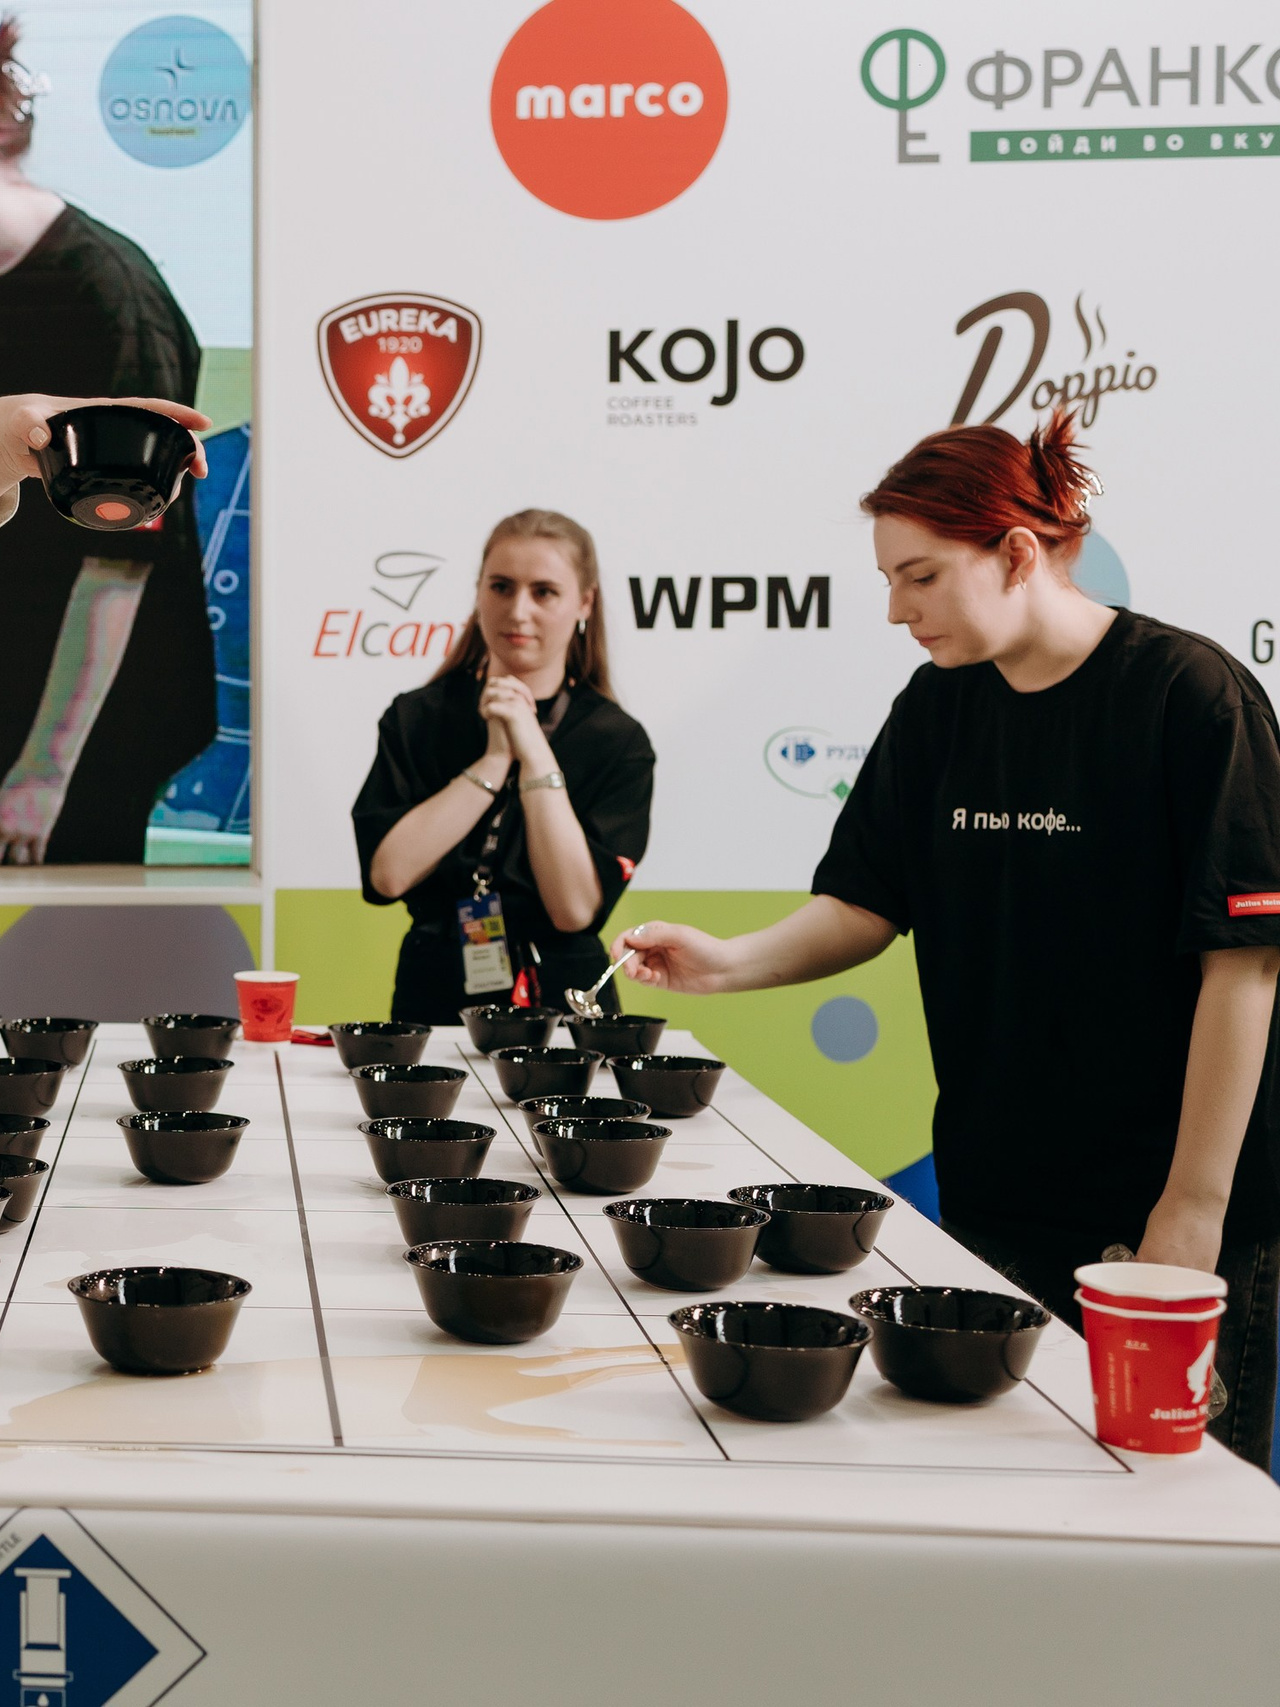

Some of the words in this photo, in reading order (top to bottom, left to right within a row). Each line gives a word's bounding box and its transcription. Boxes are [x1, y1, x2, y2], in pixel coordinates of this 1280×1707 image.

[966, 43, 1280, 111] ФРАНК
[515, 81, 705, 120] marco
[996, 133, 1117, 156] ВОЙДИ
[1143, 134, 1184, 152] ВО
[338, 307, 458, 344] EUREKA
[376, 336, 424, 354] 1920
[949, 291, 1157, 429] Doppio
[608, 319, 805, 407] KOJO
[606, 396, 674, 410] COFFEE
[606, 412, 699, 427] ROASTERS
[628, 576, 831, 629] WPM
[313, 609, 468, 658] Elcan
[951, 807, 967, 830] Я
[1017, 807, 1081, 836] кофе...
[1234, 900, 1261, 908] Julius
[1150, 1408, 1197, 1420] Julius
